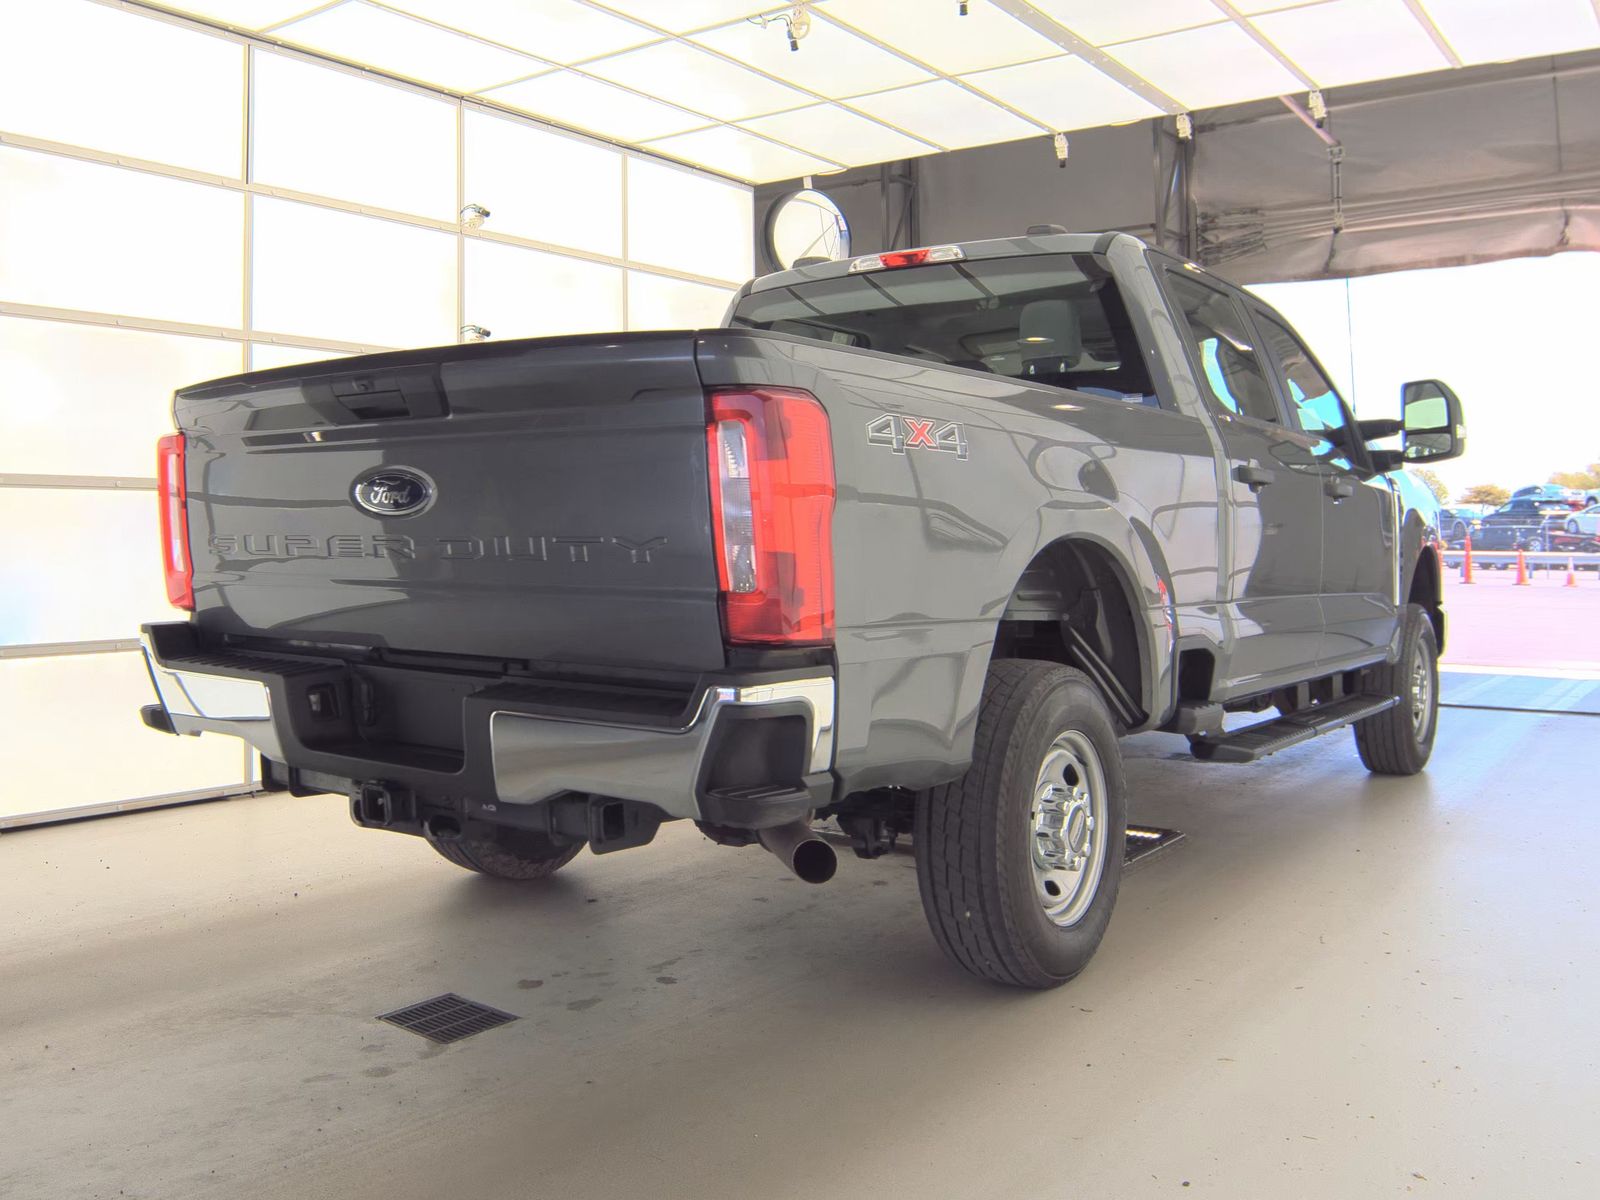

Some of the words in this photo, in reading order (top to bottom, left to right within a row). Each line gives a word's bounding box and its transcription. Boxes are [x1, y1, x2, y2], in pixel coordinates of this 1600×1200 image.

[370, 479, 411, 504] Ford
[208, 534, 416, 559] SUPER
[436, 535, 668, 564] DUTY
